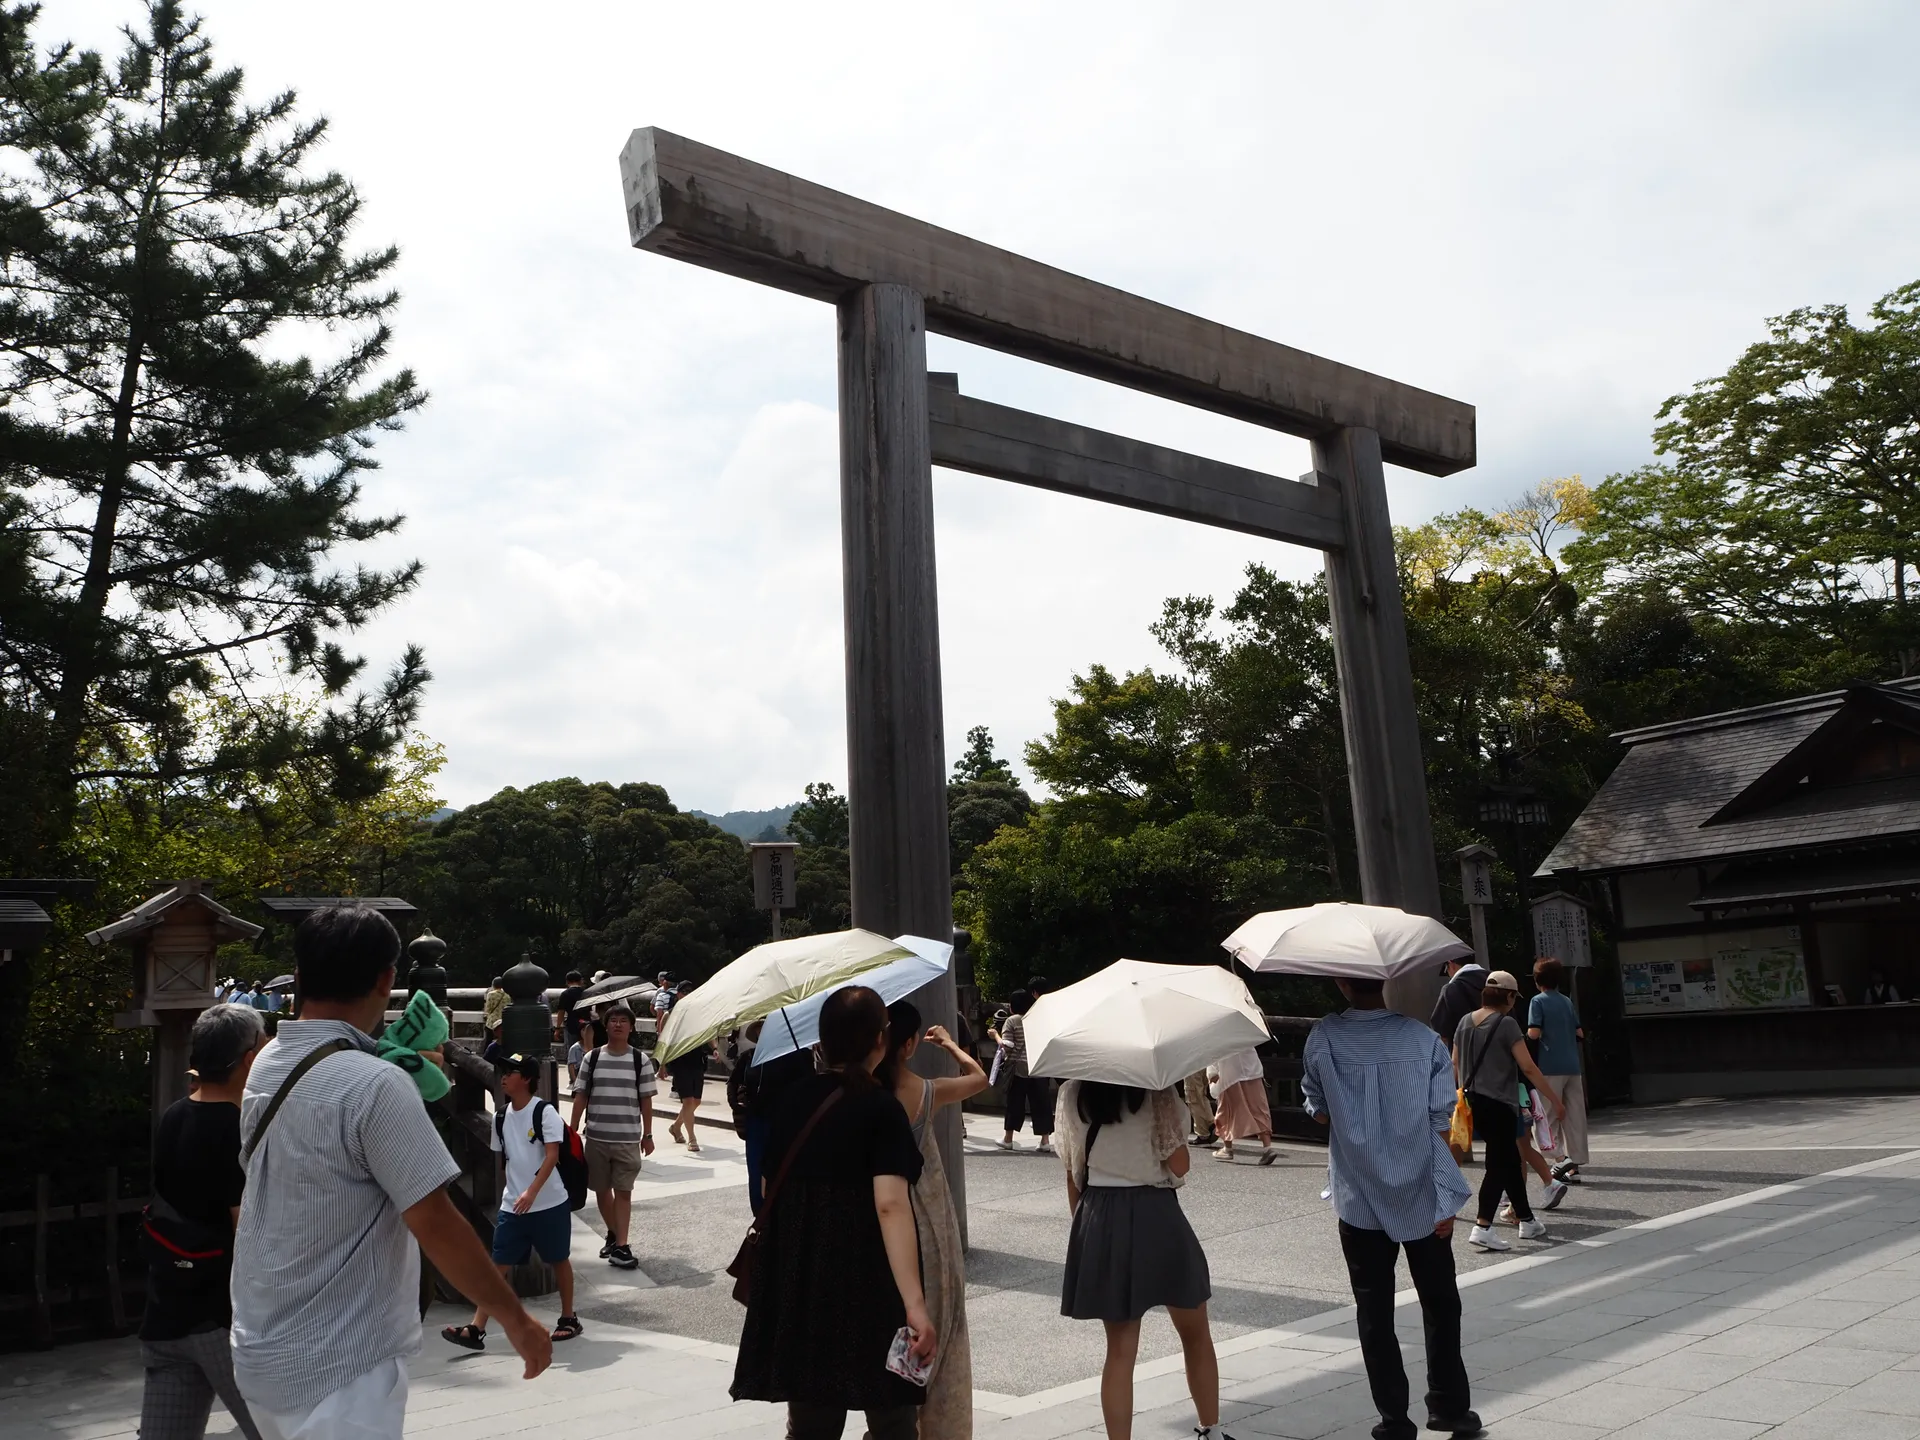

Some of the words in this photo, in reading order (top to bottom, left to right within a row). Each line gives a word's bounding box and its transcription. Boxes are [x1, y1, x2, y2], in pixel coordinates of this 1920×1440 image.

[769, 850, 784, 905] 右側通行
[1702, 980, 1716, 995] 和
